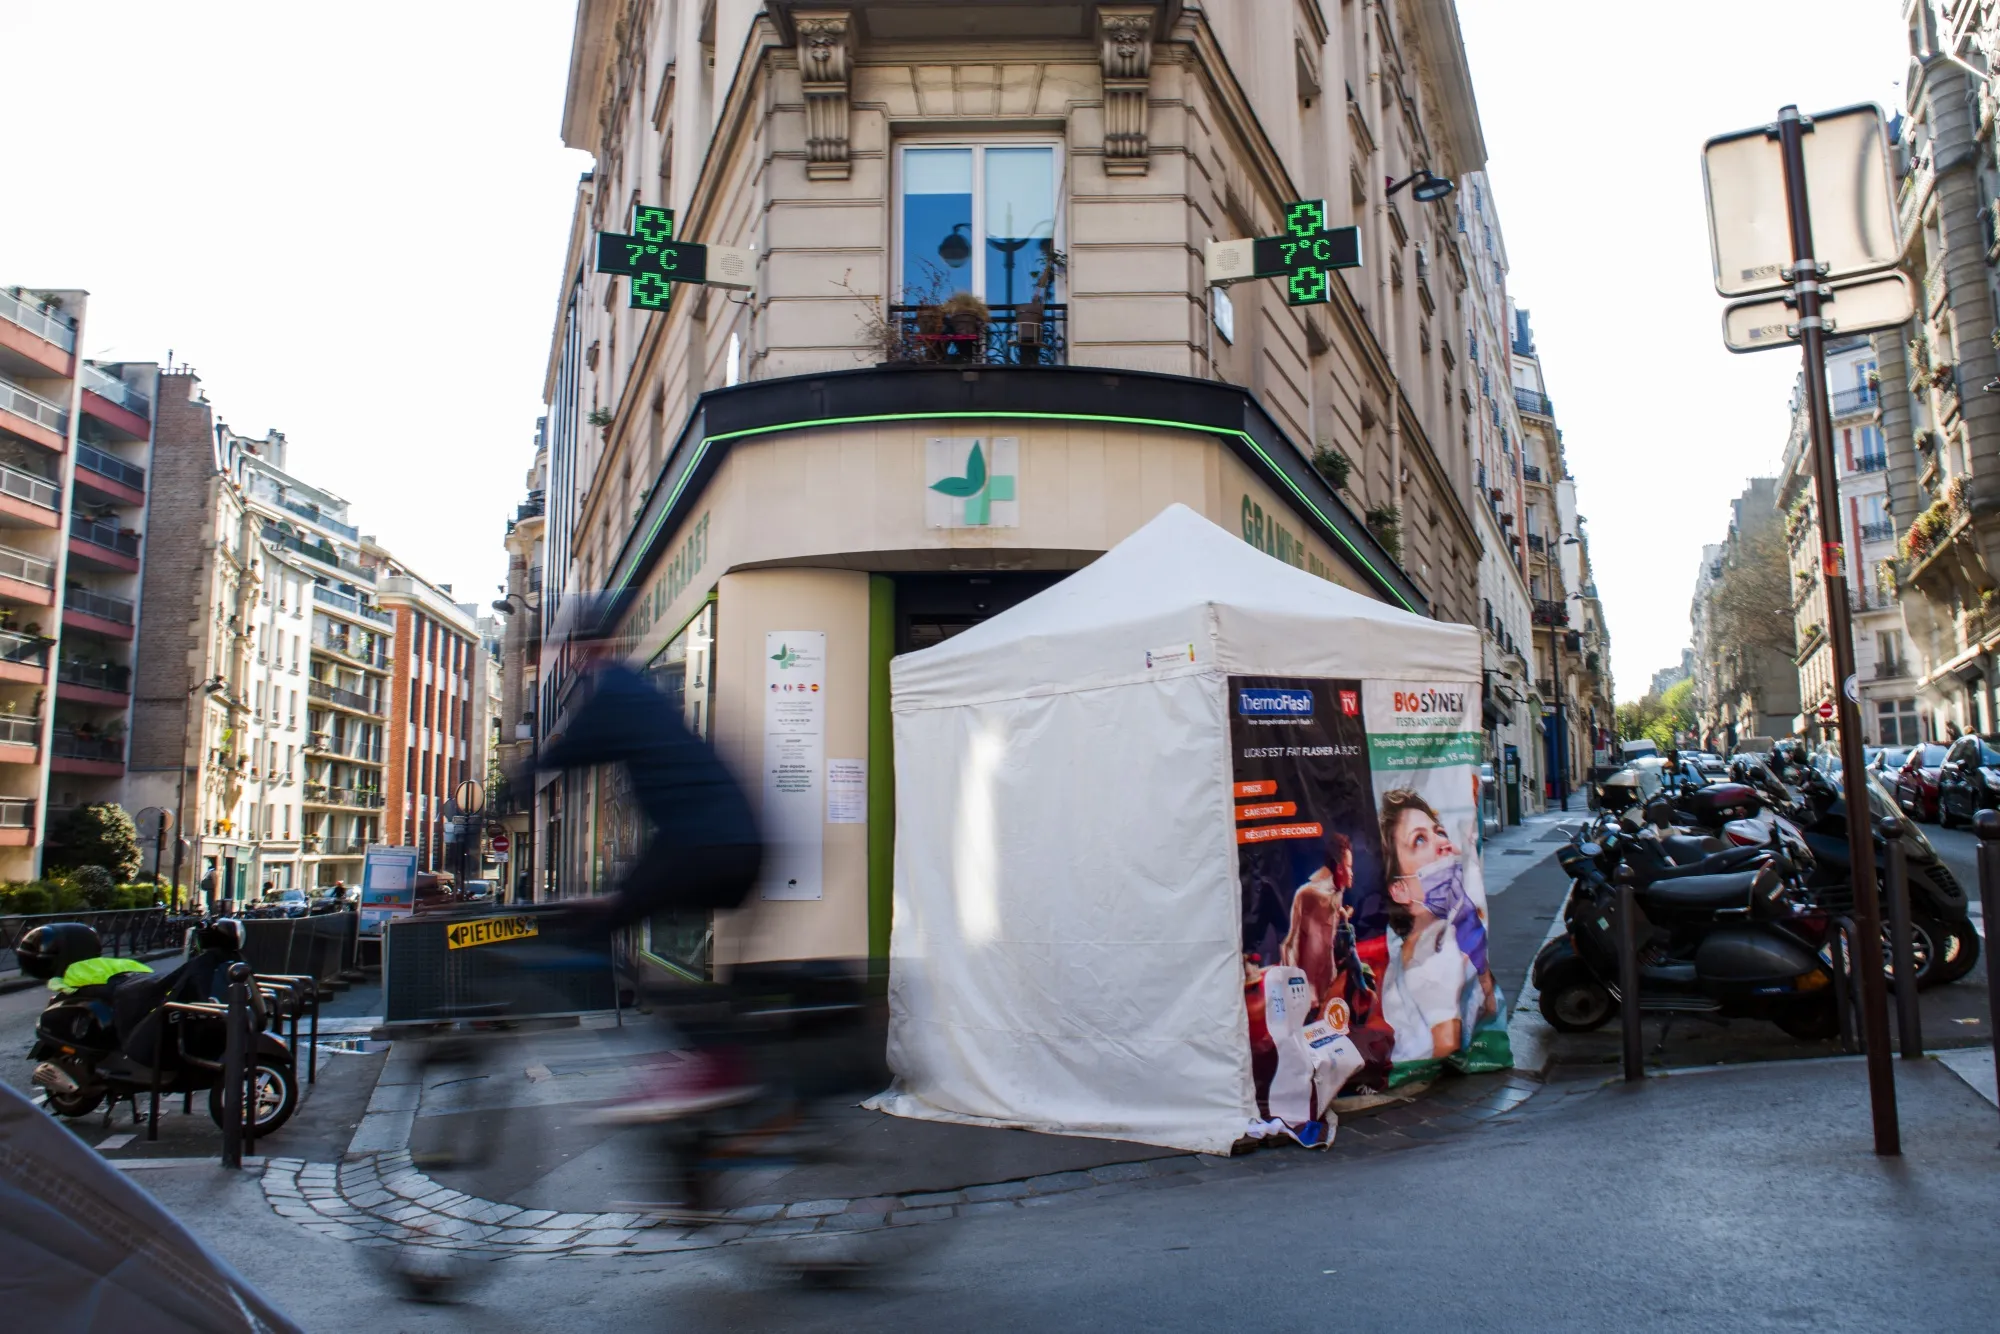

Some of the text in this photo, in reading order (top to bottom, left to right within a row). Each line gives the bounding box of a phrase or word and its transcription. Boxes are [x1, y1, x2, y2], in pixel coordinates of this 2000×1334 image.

[625, 244, 678, 270] 7°C
[1280, 239, 1331, 264] 7°C
[1240, 694, 1311, 711] ThermoFlash
[1394, 688, 1464, 712] BIOSYNEX
[1281, 825, 1318, 836] SECONDE
[460, 917, 525, 944] PIETONS
